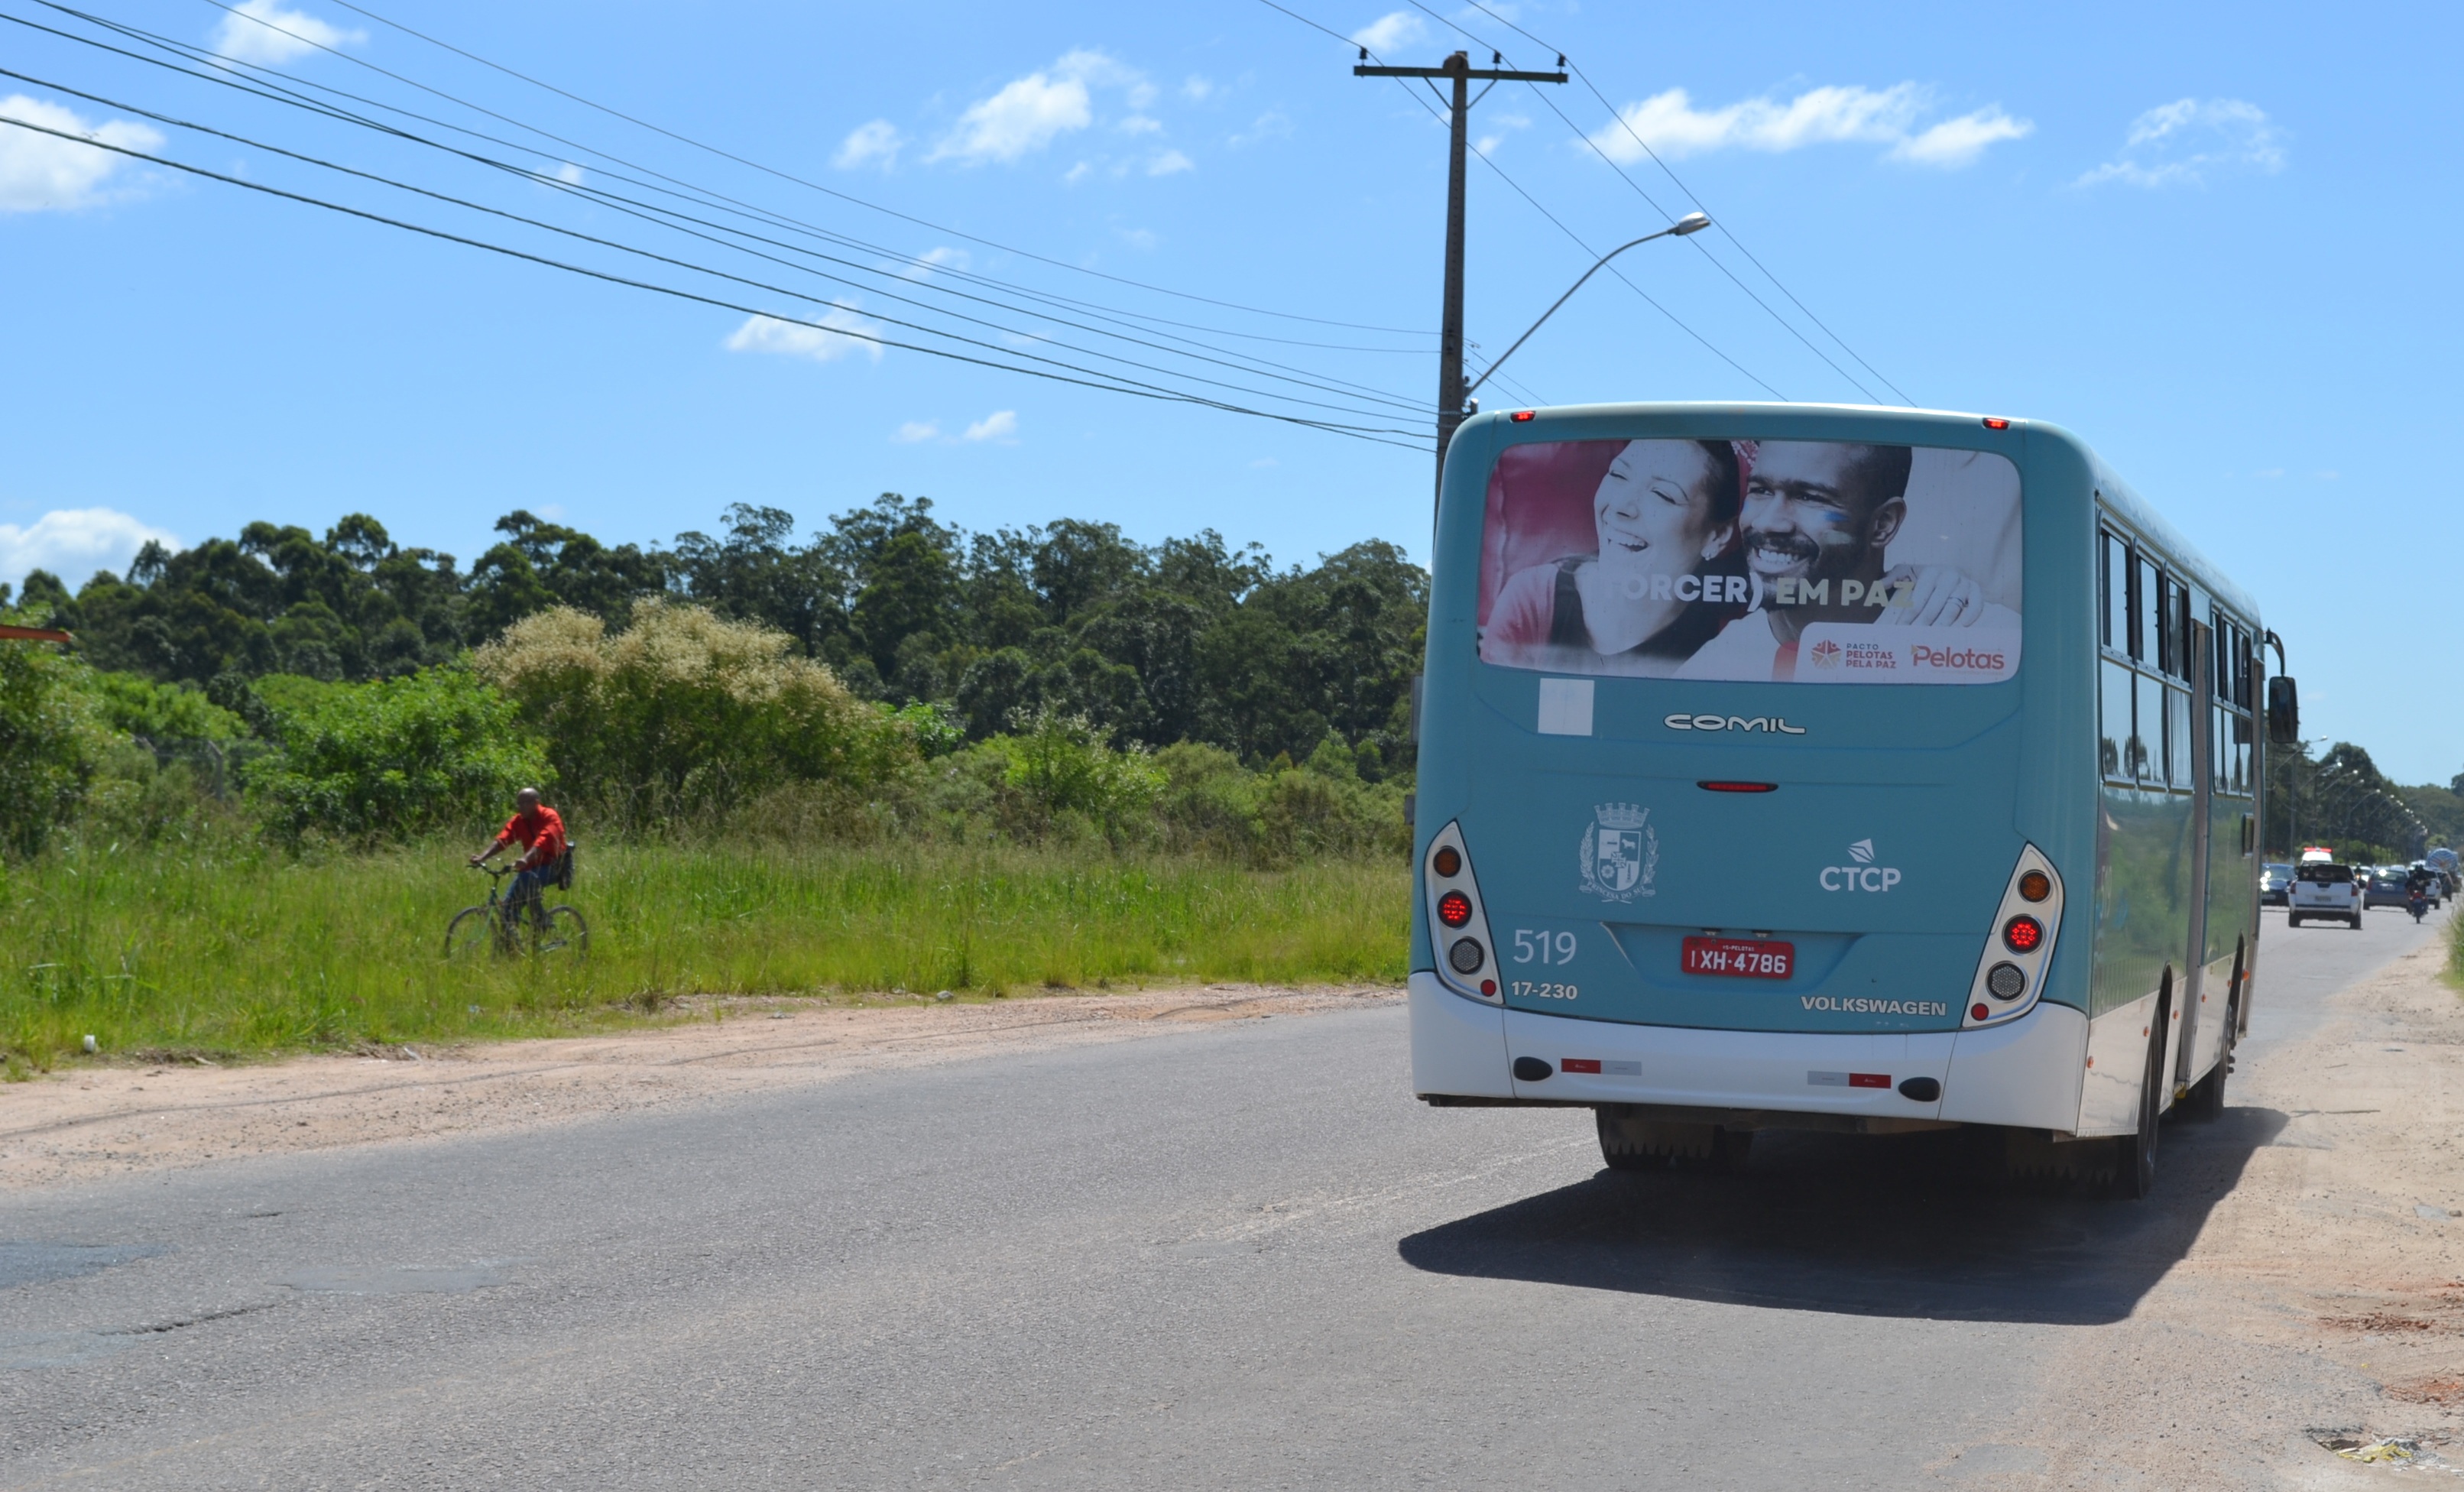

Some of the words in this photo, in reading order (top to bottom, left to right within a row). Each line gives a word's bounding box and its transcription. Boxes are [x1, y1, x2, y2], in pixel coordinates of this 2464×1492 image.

[1776, 578, 1829, 605] EM
[1841, 579, 1914, 608] PAZ
[1846, 650, 1893, 660] PELOTAS
[1846, 660, 1872, 668] PELA
[1912, 645, 2005, 670] Pelotas
[1664, 713, 1806, 734] COMIL
[1820, 866, 1901, 892] CTCP
[1513, 929, 1577, 965] 519
[1511, 981, 1578, 1000] 17-230
[1800, 995, 1947, 1016] VOLKSWAGEN
